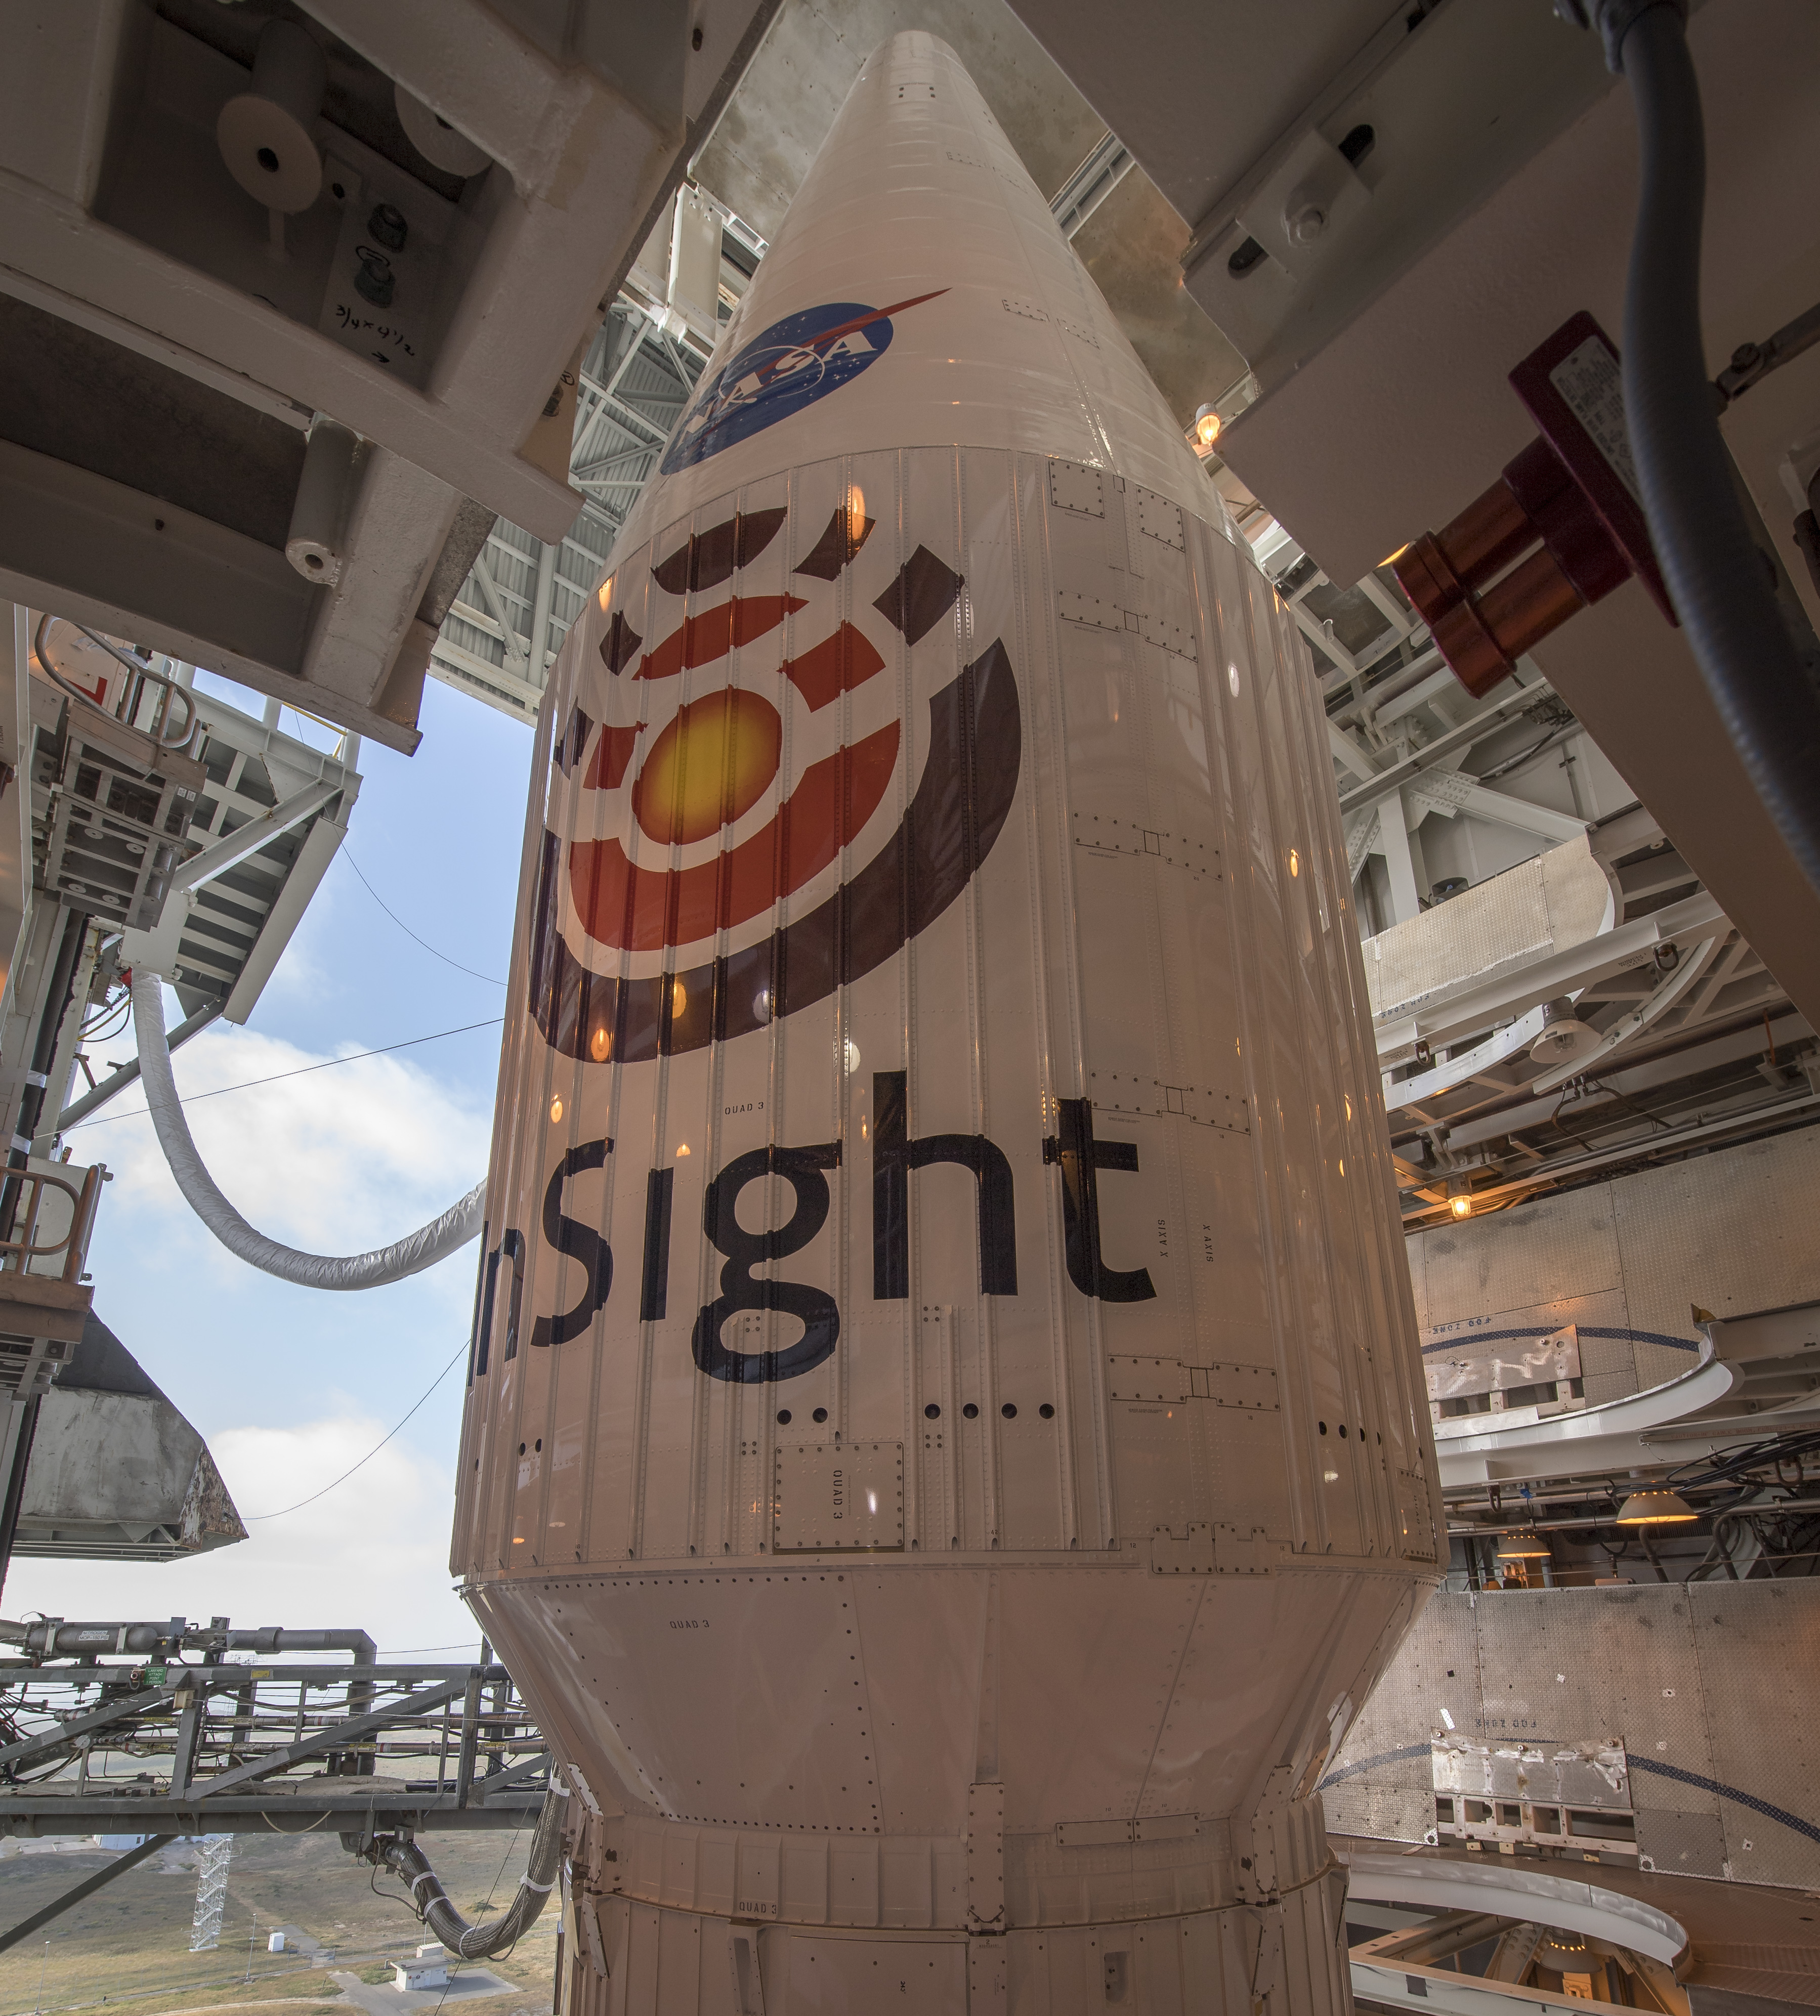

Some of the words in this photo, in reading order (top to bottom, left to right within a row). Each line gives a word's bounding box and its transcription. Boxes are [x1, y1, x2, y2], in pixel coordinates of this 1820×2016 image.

[674, 331, 878, 452] NASA
[725, 1103, 753, 1116] QUAD
[758, 1101, 764, 1110] 3
[1158, 1219, 1167, 1246] AXIS
[1204, 1236, 1214, 1262] AXIS
[833, 1469, 843, 1506] QUAD
[833, 1512, 843, 1520] 3
[669, 1620, 699, 1629] QUAD
[703, 1619, 710, 1628] 3
[739, 1902, 767, 1914] QUAD
[772, 1903, 778, 1915] 3
